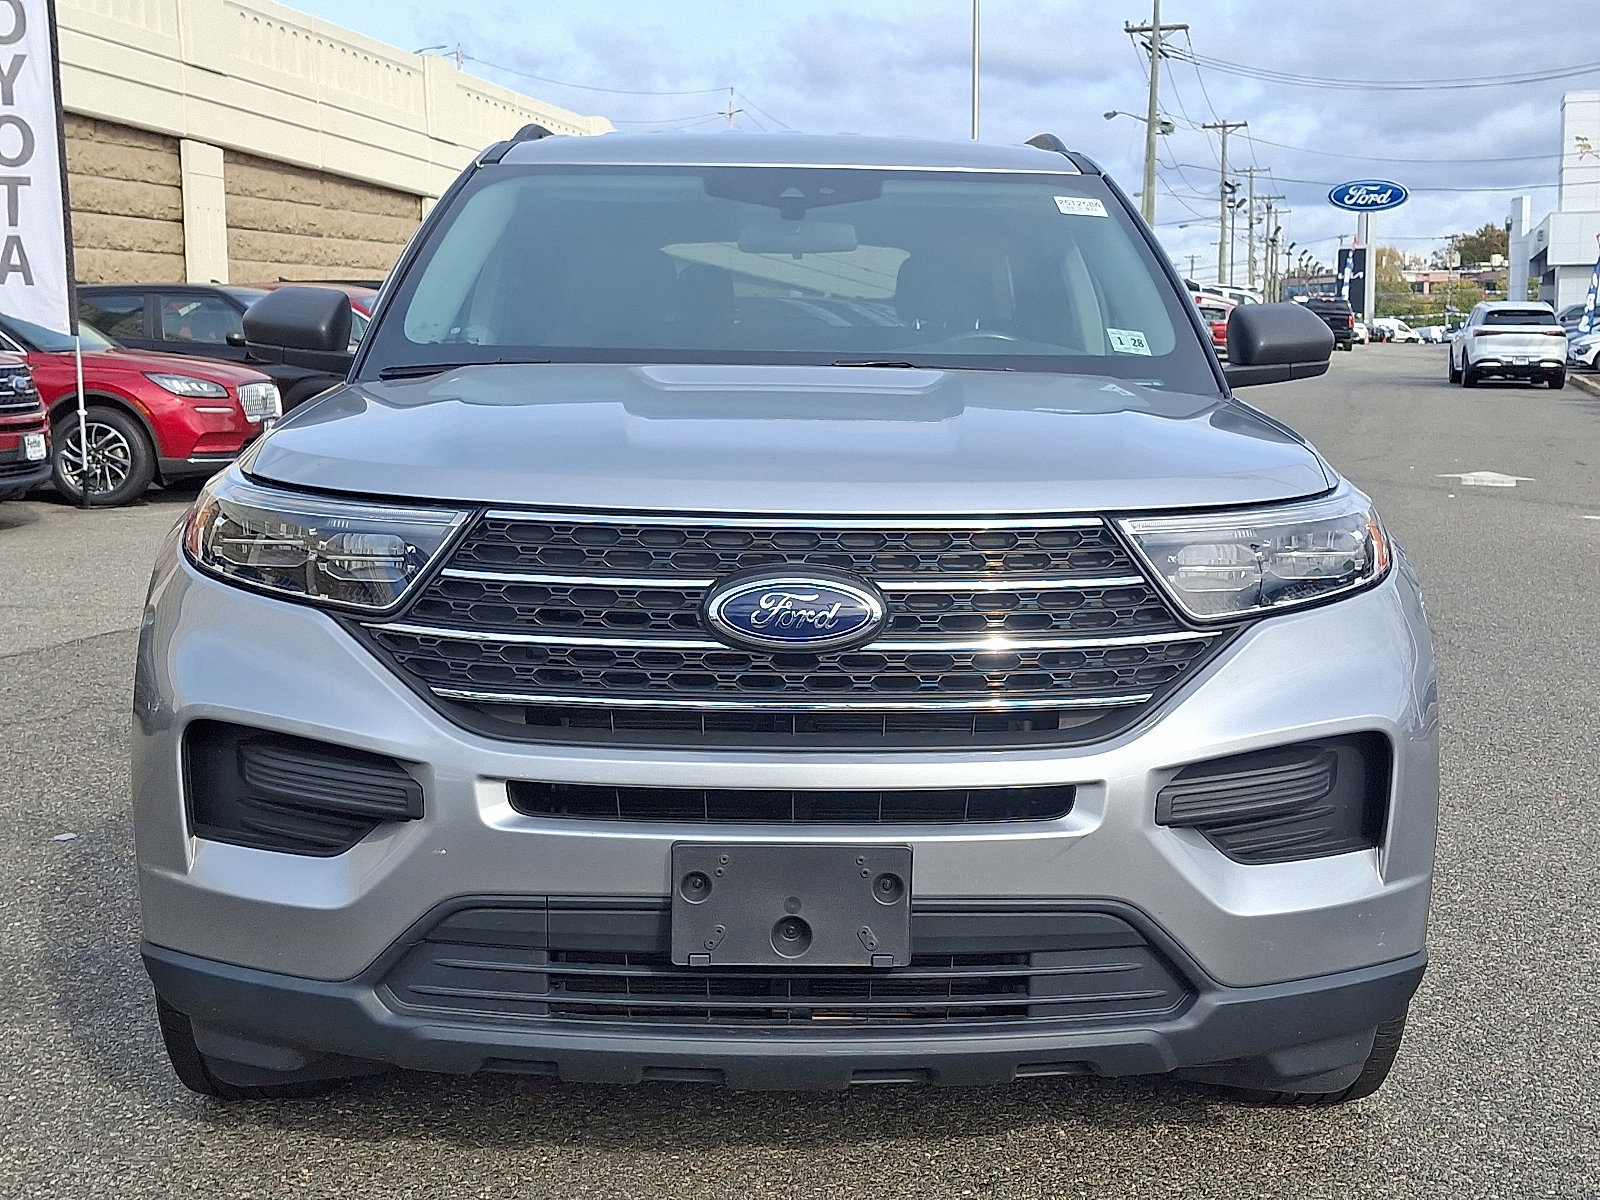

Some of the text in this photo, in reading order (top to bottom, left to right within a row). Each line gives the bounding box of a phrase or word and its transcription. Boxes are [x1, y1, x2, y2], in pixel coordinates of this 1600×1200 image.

[1344, 185, 1393, 205] Ford
[1117, 336, 1145, 348] 1 28
[750, 591, 842, 629] Ford
